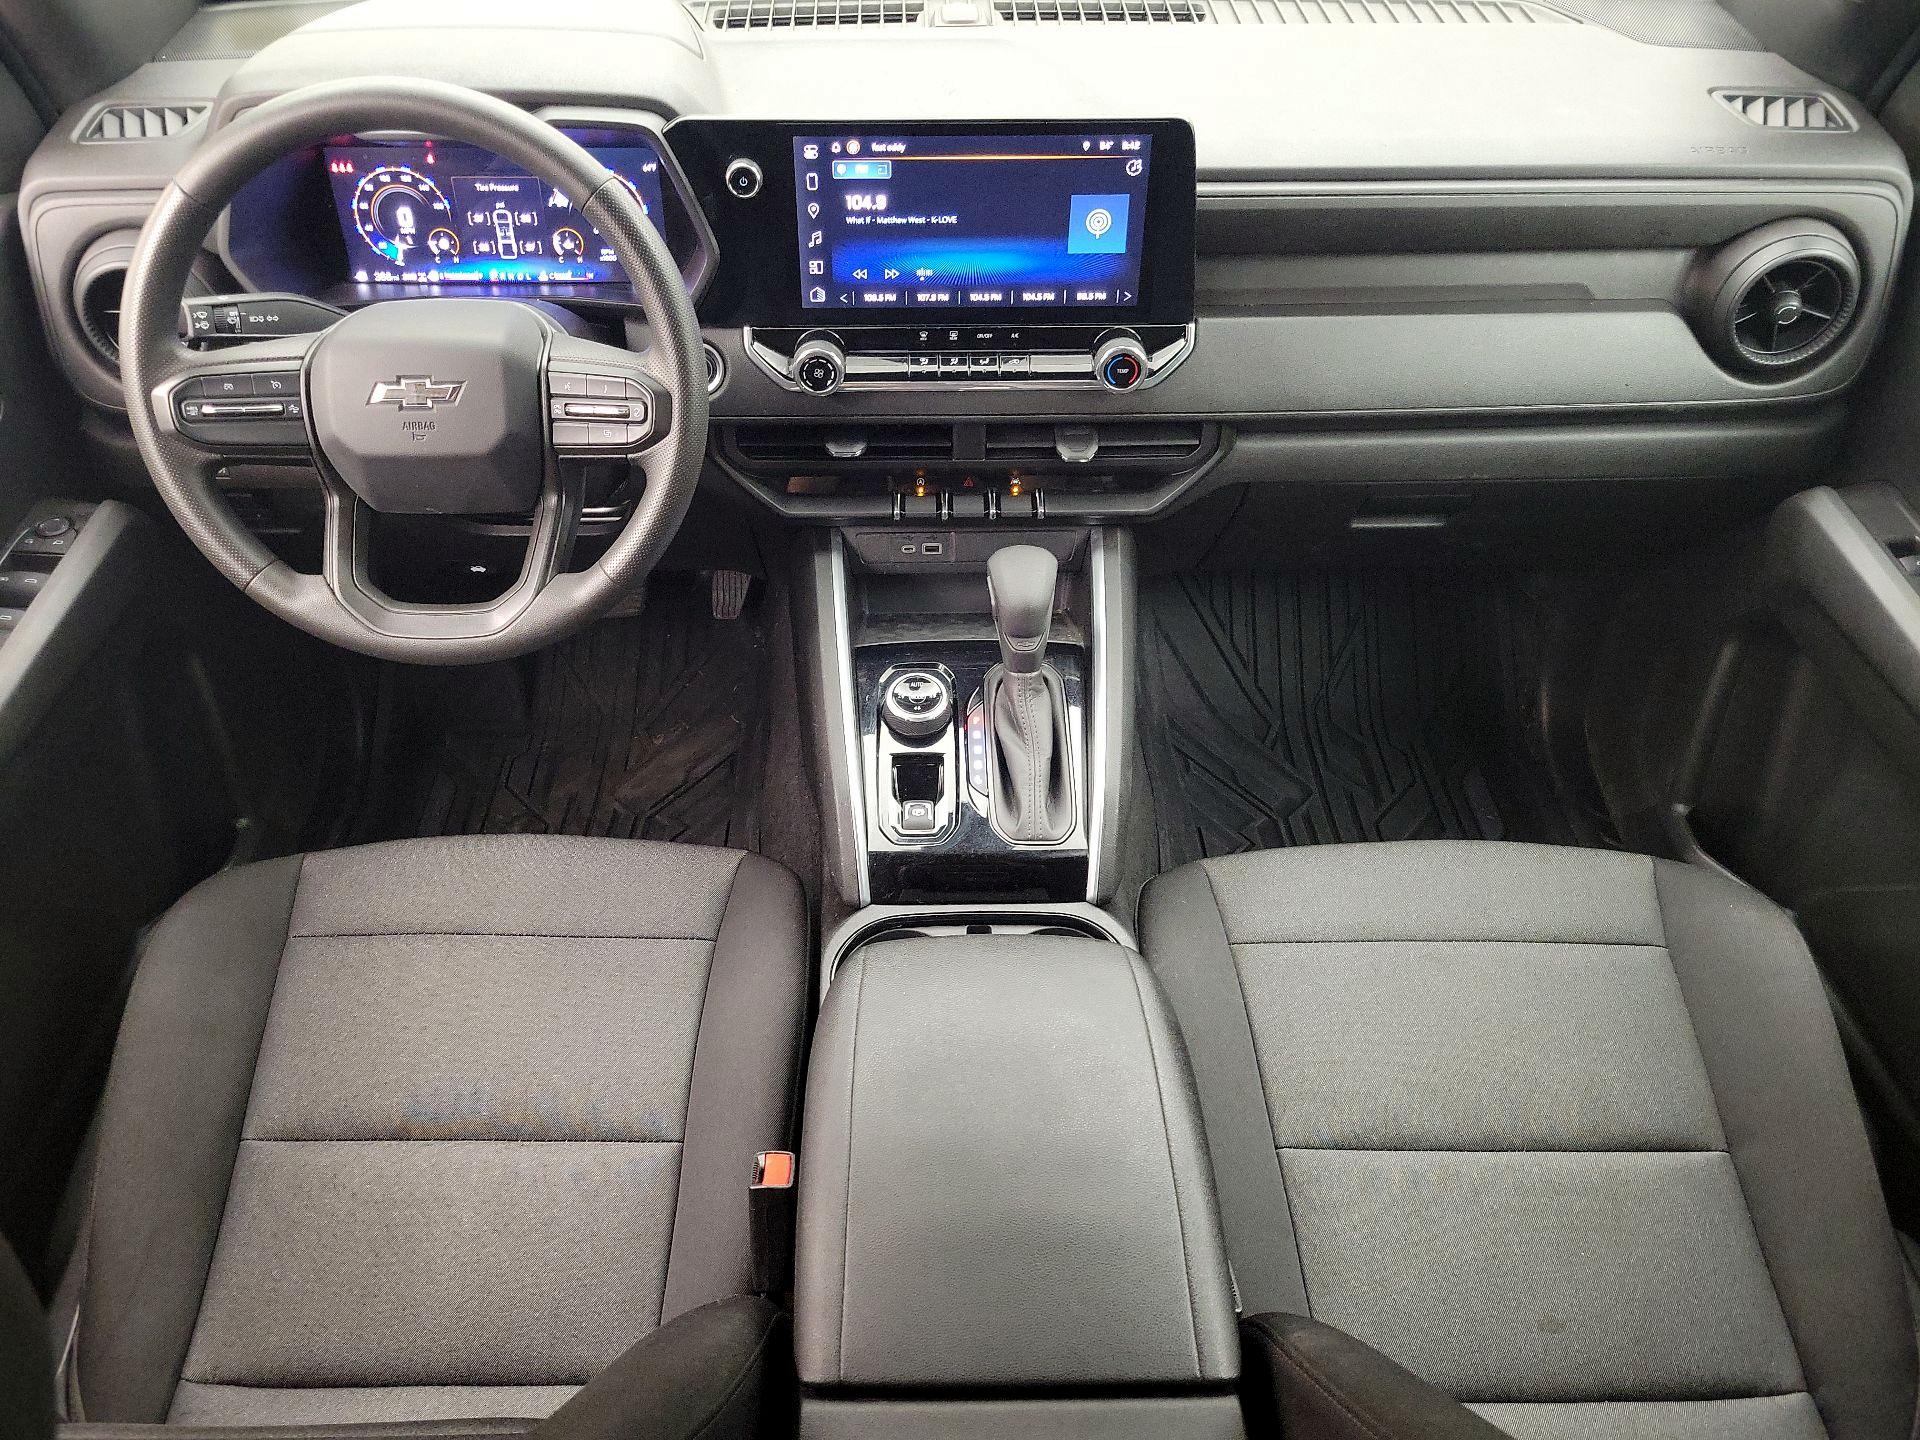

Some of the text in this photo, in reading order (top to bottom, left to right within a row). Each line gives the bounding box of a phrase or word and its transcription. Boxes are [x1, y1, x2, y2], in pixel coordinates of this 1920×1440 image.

[846, 216, 864, 224] What
[877, 216, 907, 224] Matthew
[908, 216, 926, 224] West
[402, 421, 436, 430] AIRBAG
